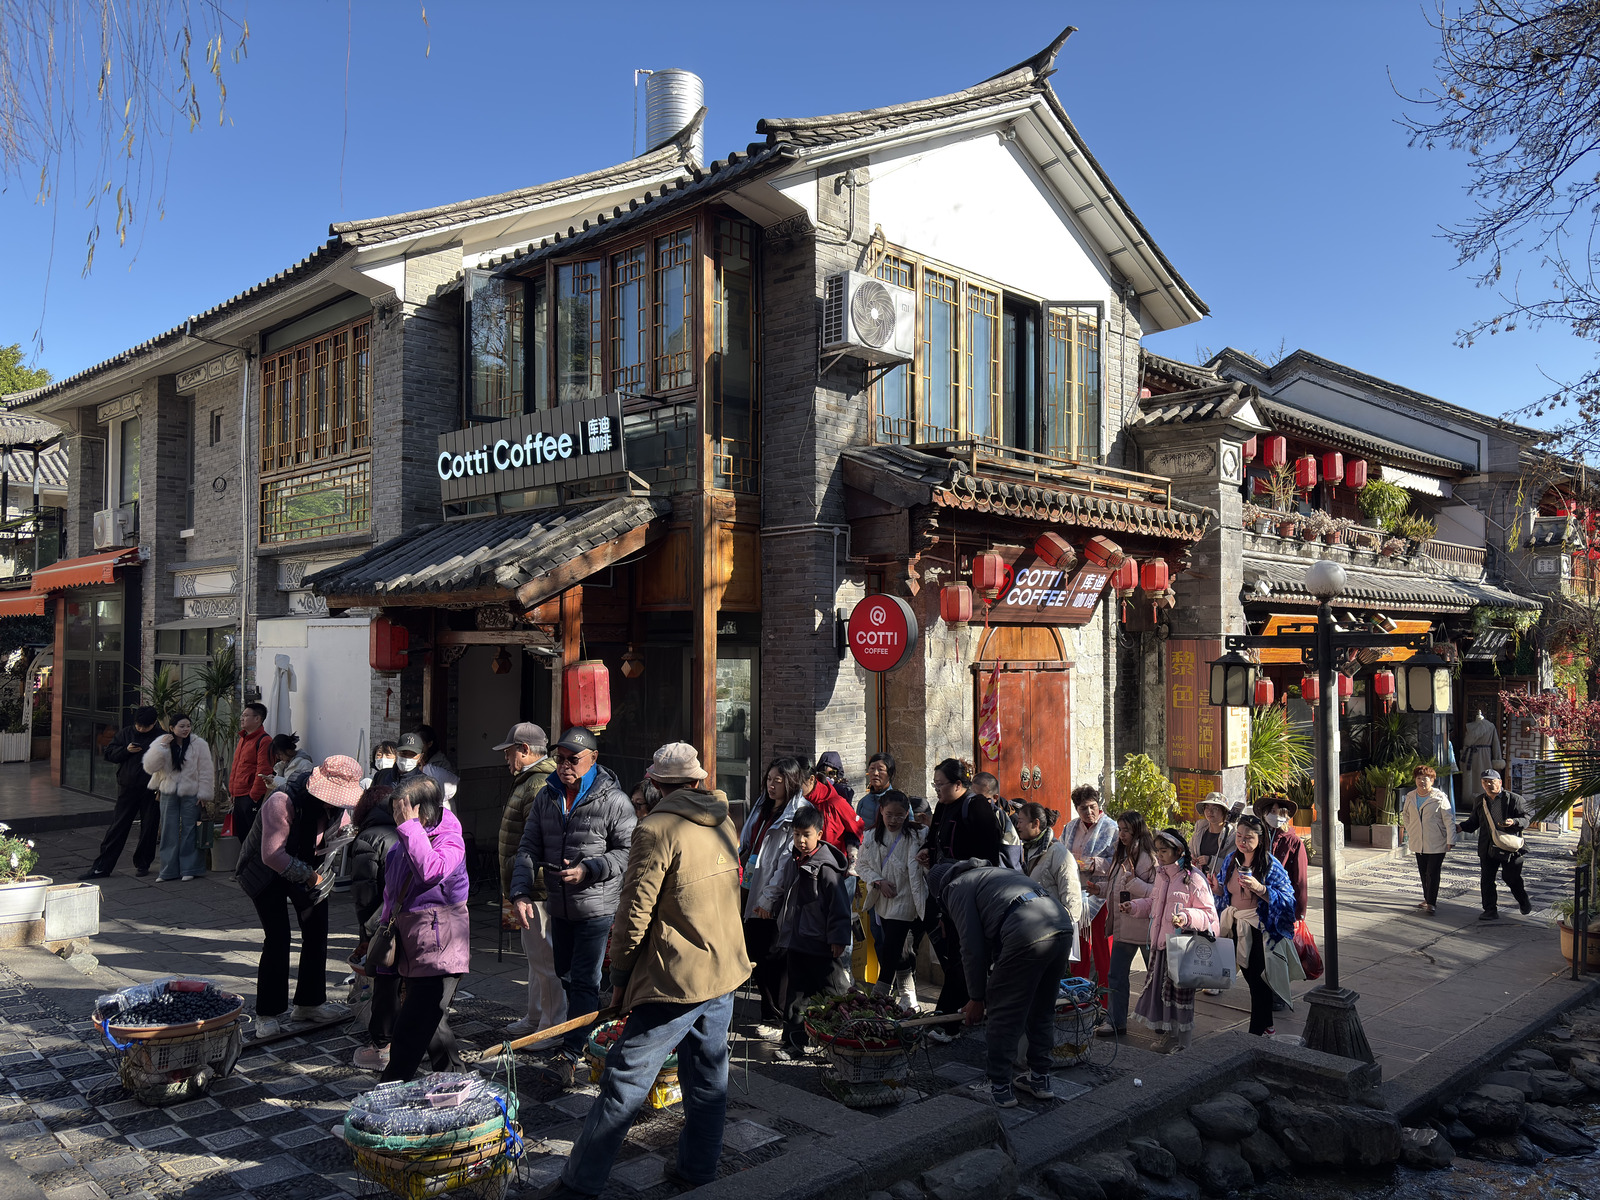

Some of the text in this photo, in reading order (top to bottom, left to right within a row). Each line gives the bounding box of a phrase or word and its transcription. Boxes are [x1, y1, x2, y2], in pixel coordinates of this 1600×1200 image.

[588, 415, 611, 437] 库迪
[588, 433, 613, 453] 咖啡
[437, 431, 573, 481] Cotti Coffee
[1015, 568, 1064, 588] COTTI
[1080, 573, 1107, 591] 库迪
[1006, 588, 1068, 607] COFFEE
[1072, 592, 1099, 609] 咖啡
[856, 630, 898, 646] COTTI
[863, 647, 889, 655] COFFEE
[1171, 650, 1196, 709] 黎色
[1172, 742, 1193, 750] MUSIC
